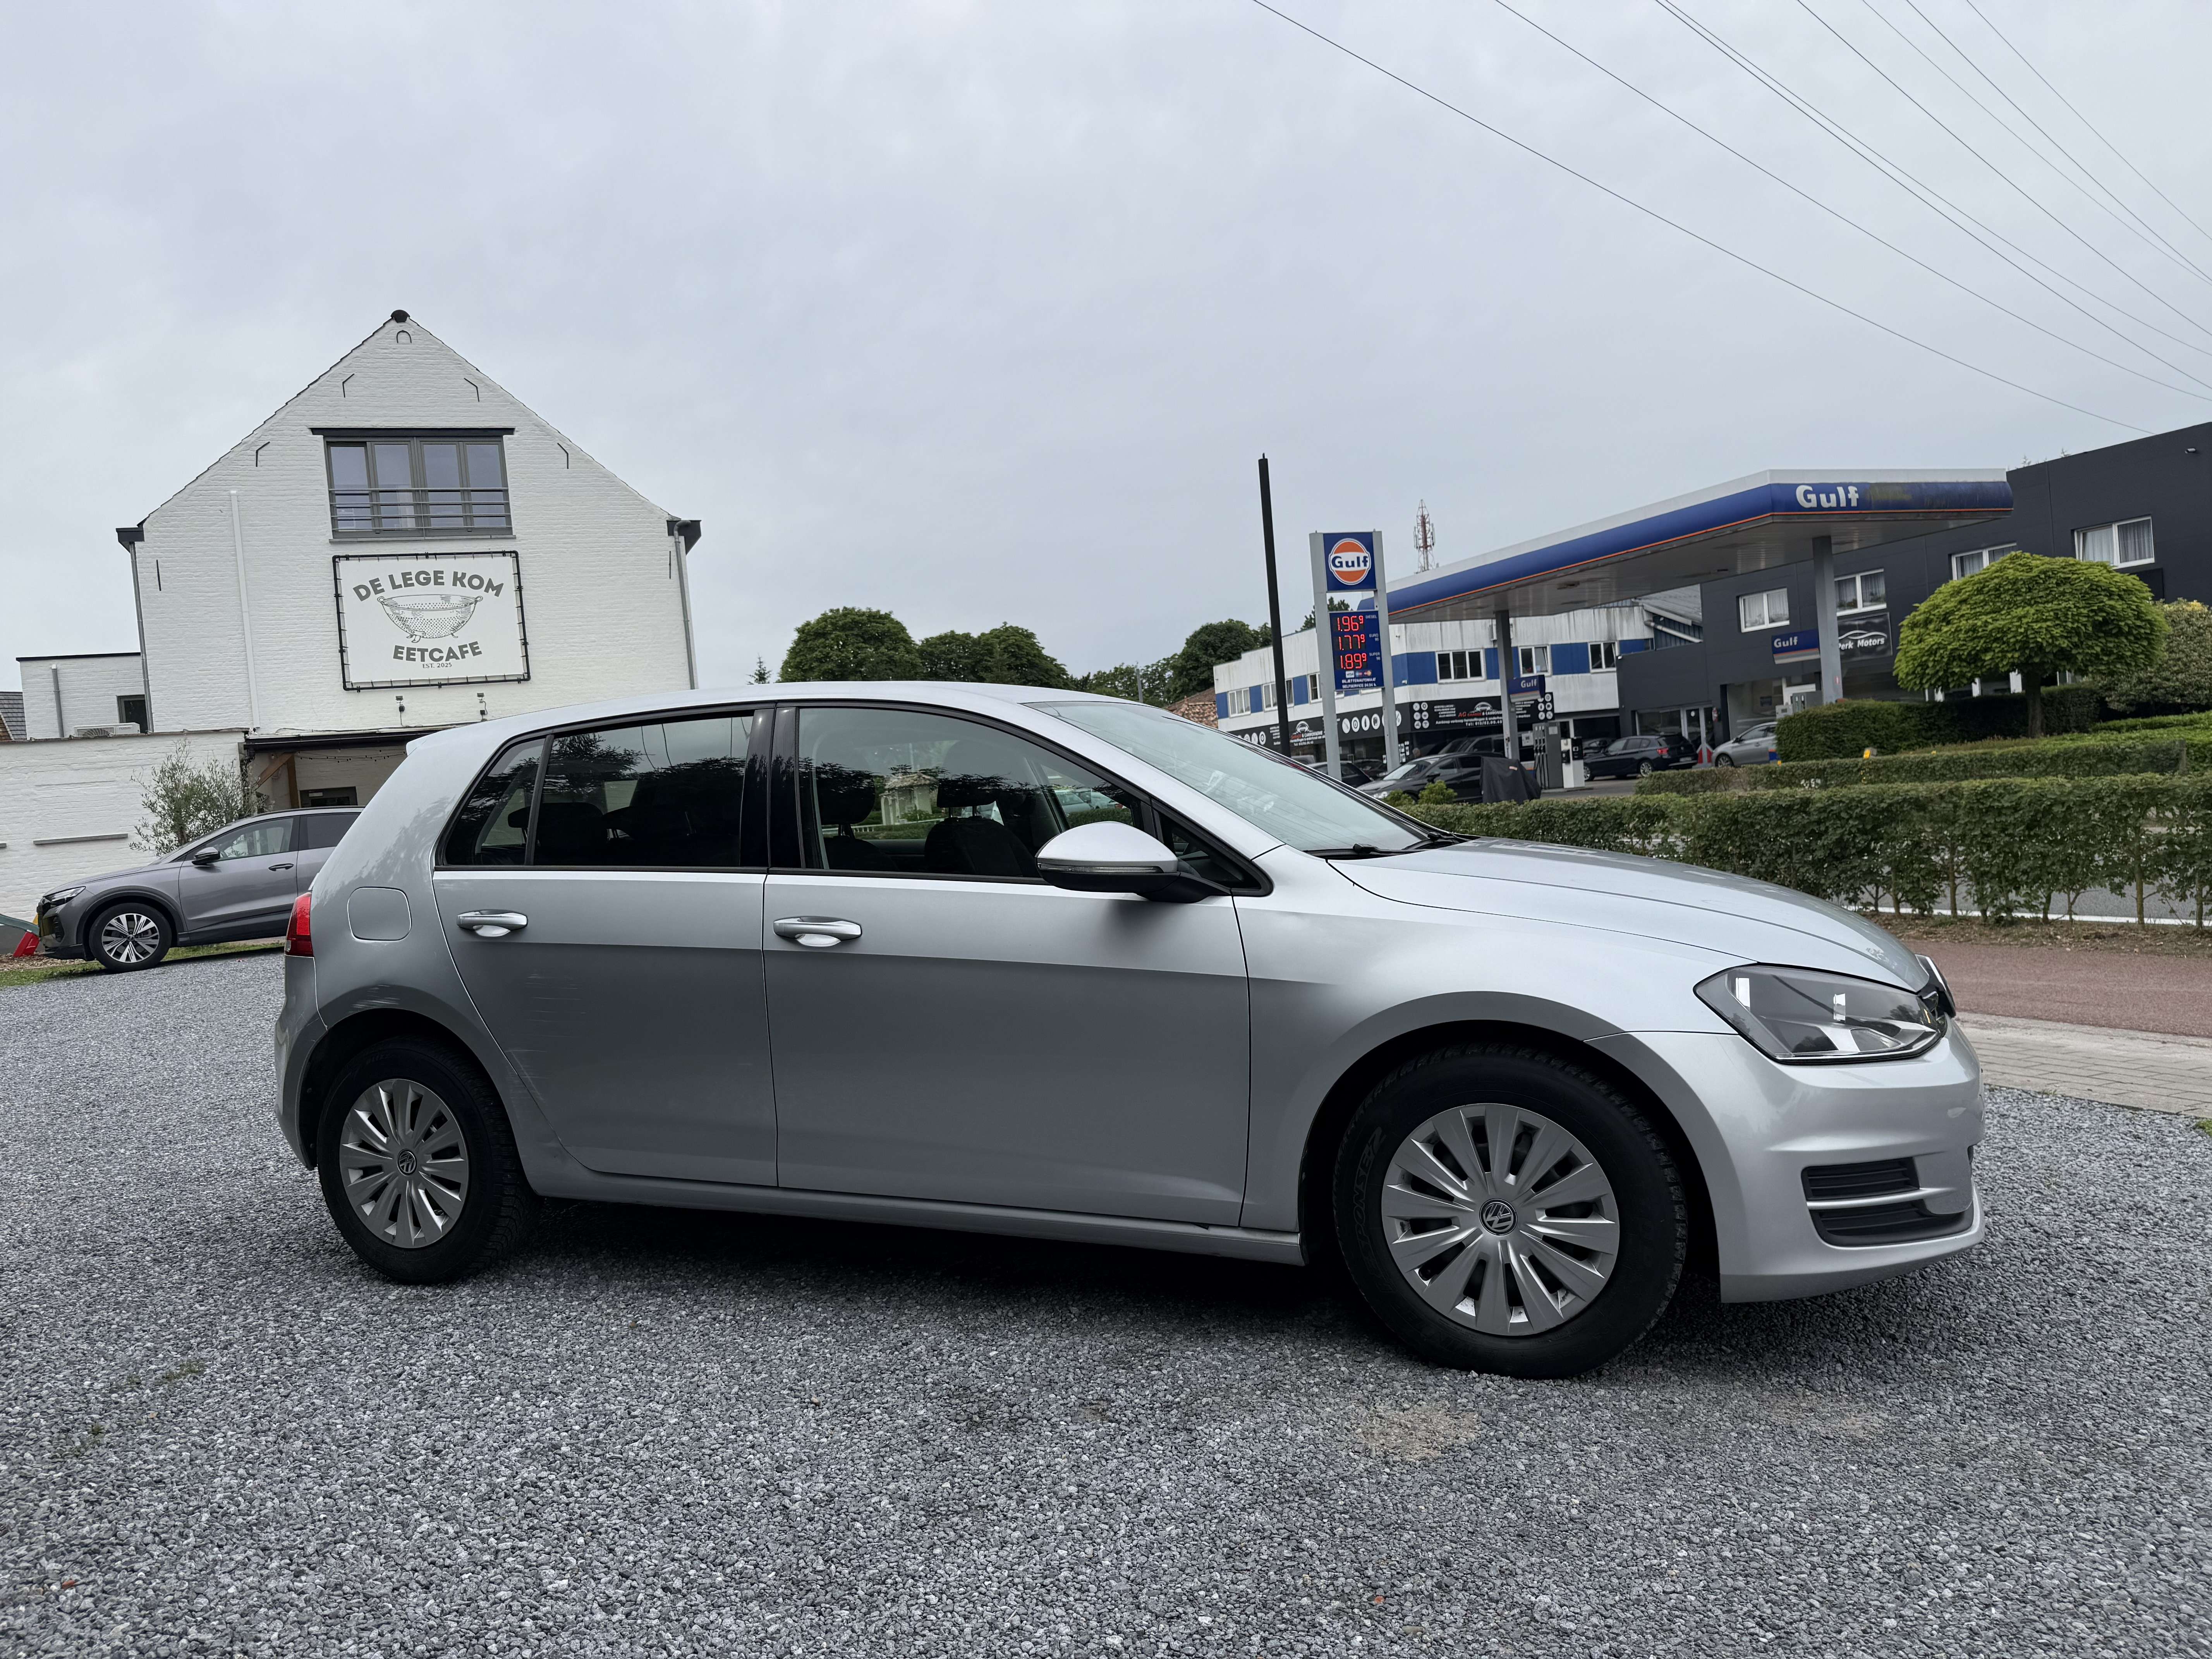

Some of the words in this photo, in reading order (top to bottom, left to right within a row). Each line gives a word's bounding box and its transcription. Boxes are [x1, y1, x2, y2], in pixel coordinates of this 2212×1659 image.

[1796, 485, 1859, 508] Gulf
[1331, 555, 1369, 568] Gulf
[353, 578, 385, 601] DE
[388, 570, 445, 590] LEGE
[452, 571, 504, 597] KOM
[1774, 636, 1798, 648] Gulf
[1857, 637, 1884, 648] Motors
[393, 641, 482, 662] EETCAFE
[1521, 679, 1537, 688] Gulf
